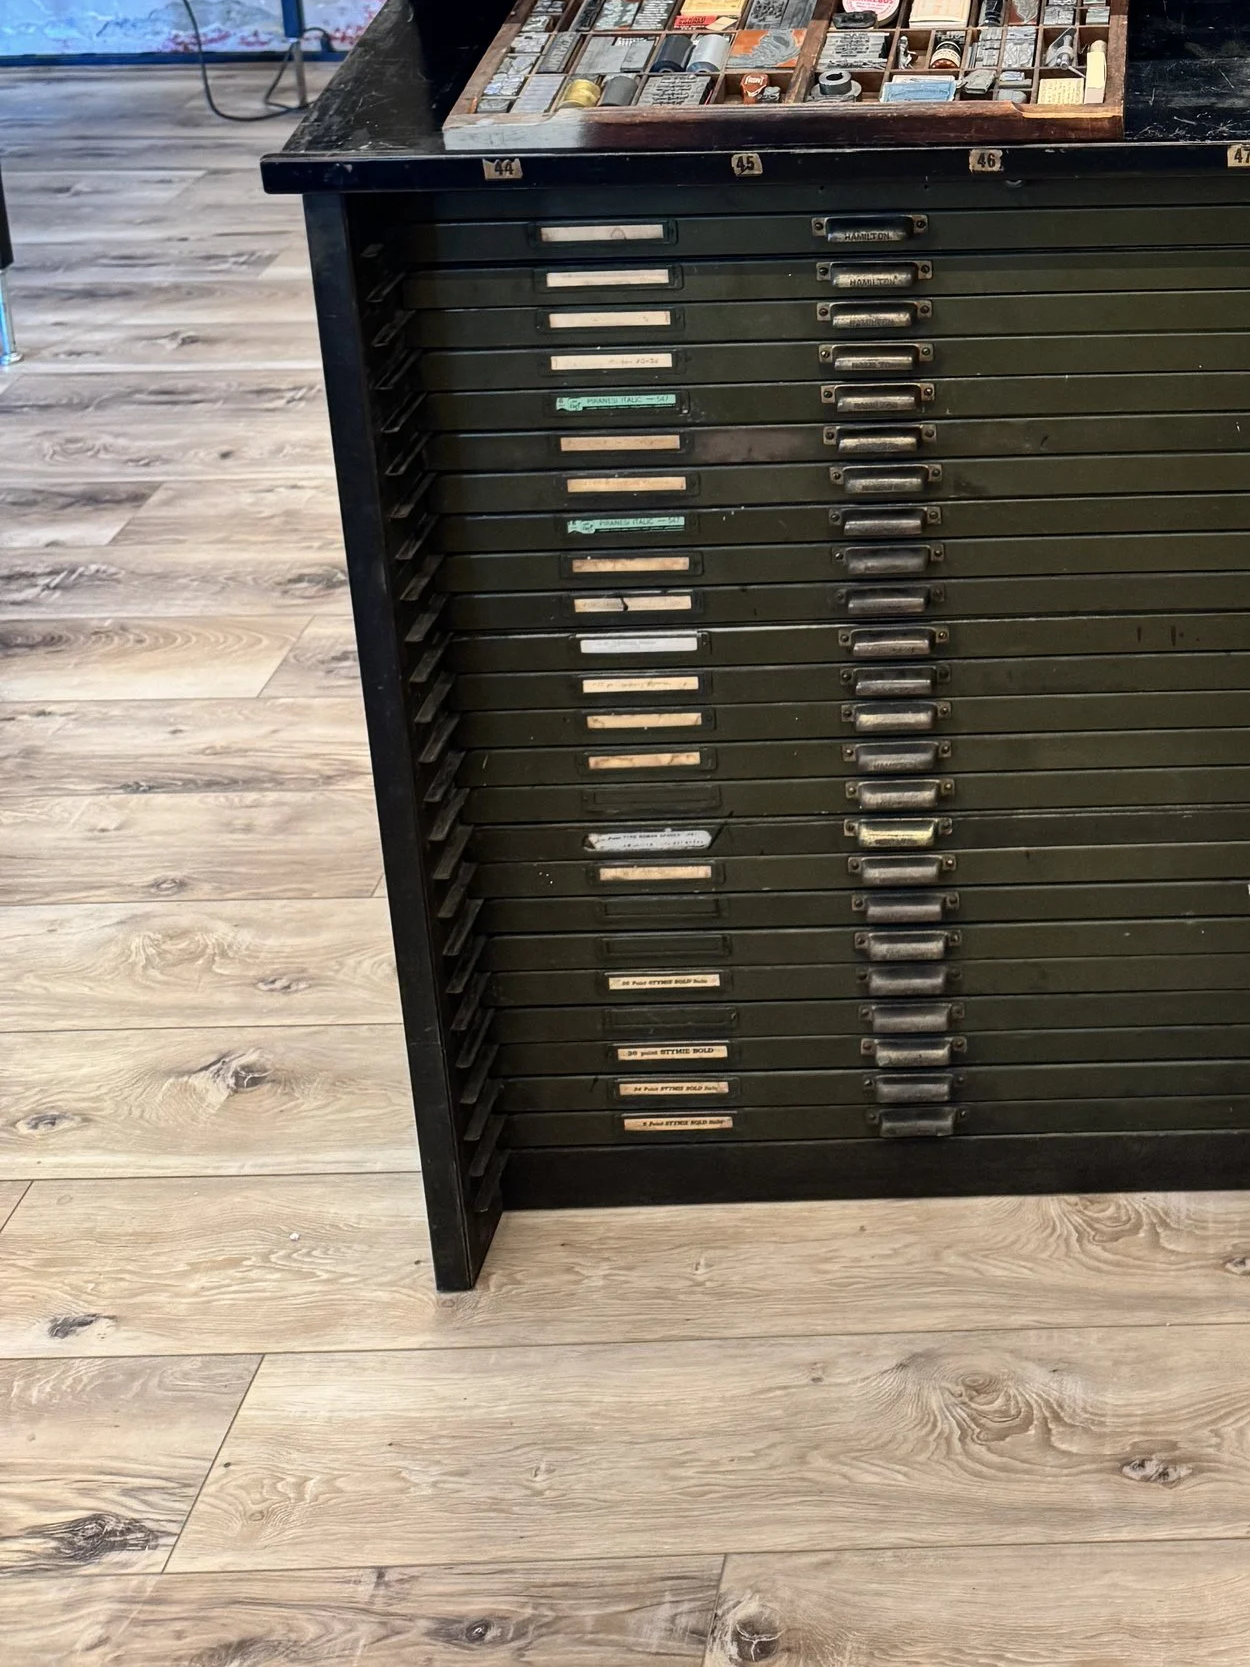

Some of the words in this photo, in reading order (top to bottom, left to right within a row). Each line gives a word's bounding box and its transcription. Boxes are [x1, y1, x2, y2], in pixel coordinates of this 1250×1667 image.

[736, 153, 755, 173] 45
[976, 152, 996, 169] 46
[494, 159, 514, 176] 44
[844, 231, 890, 241] HAMILTON
[849, 277, 896, 287] HAMILTON
[660, 1047, 691, 1055] STYMIE
